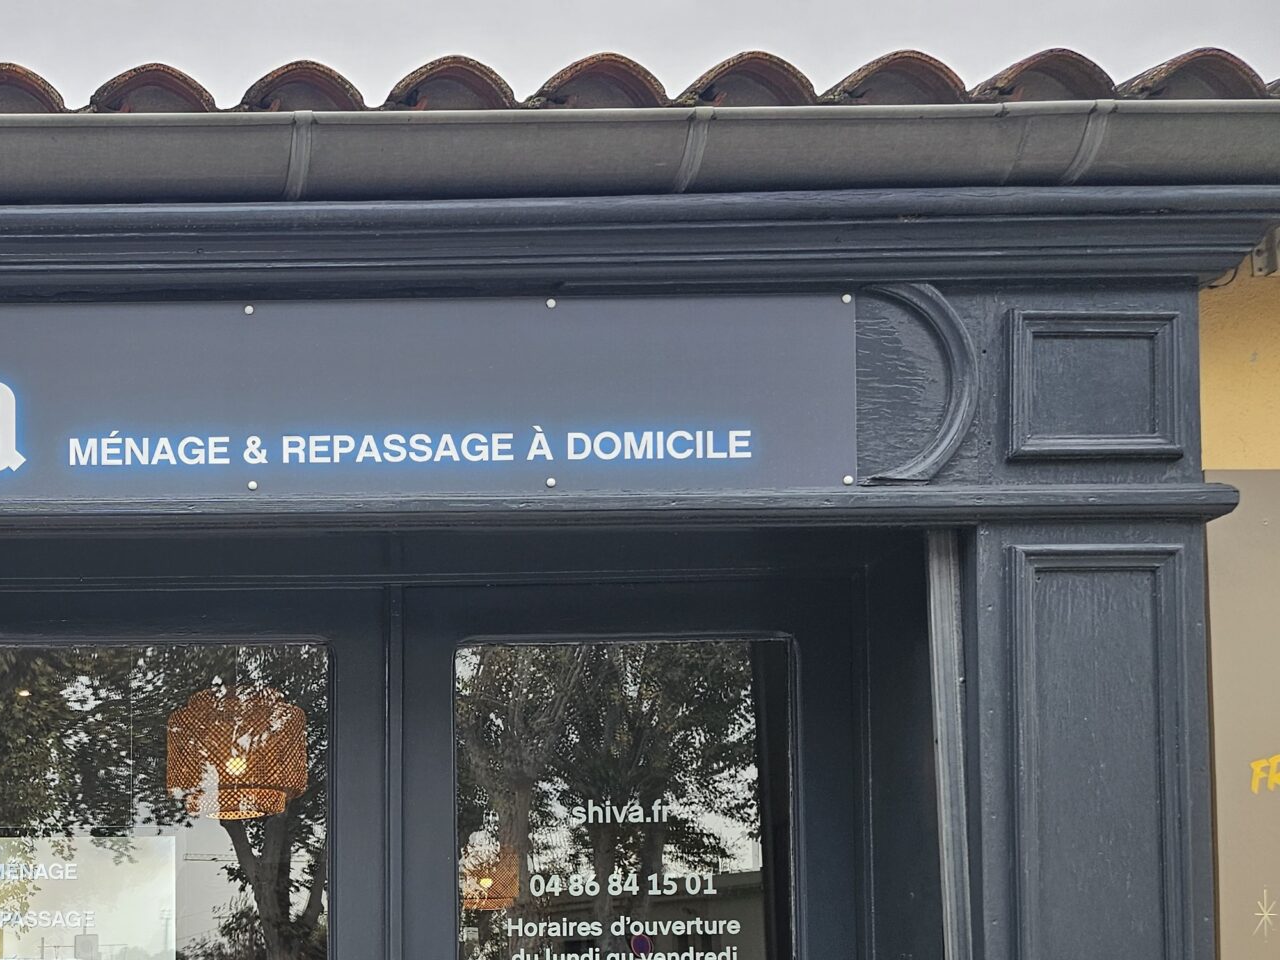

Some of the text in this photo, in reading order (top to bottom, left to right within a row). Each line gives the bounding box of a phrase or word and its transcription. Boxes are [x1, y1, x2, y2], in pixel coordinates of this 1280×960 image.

[68, 426, 752, 467] MÉNAGE & REPASSAGE À DOMICILE
[570, 799, 669, 824] shiva.fr
[529, 873, 717, 897] 04 86 84 15 01
[507, 916, 741, 937] Horaires d'ouverture
